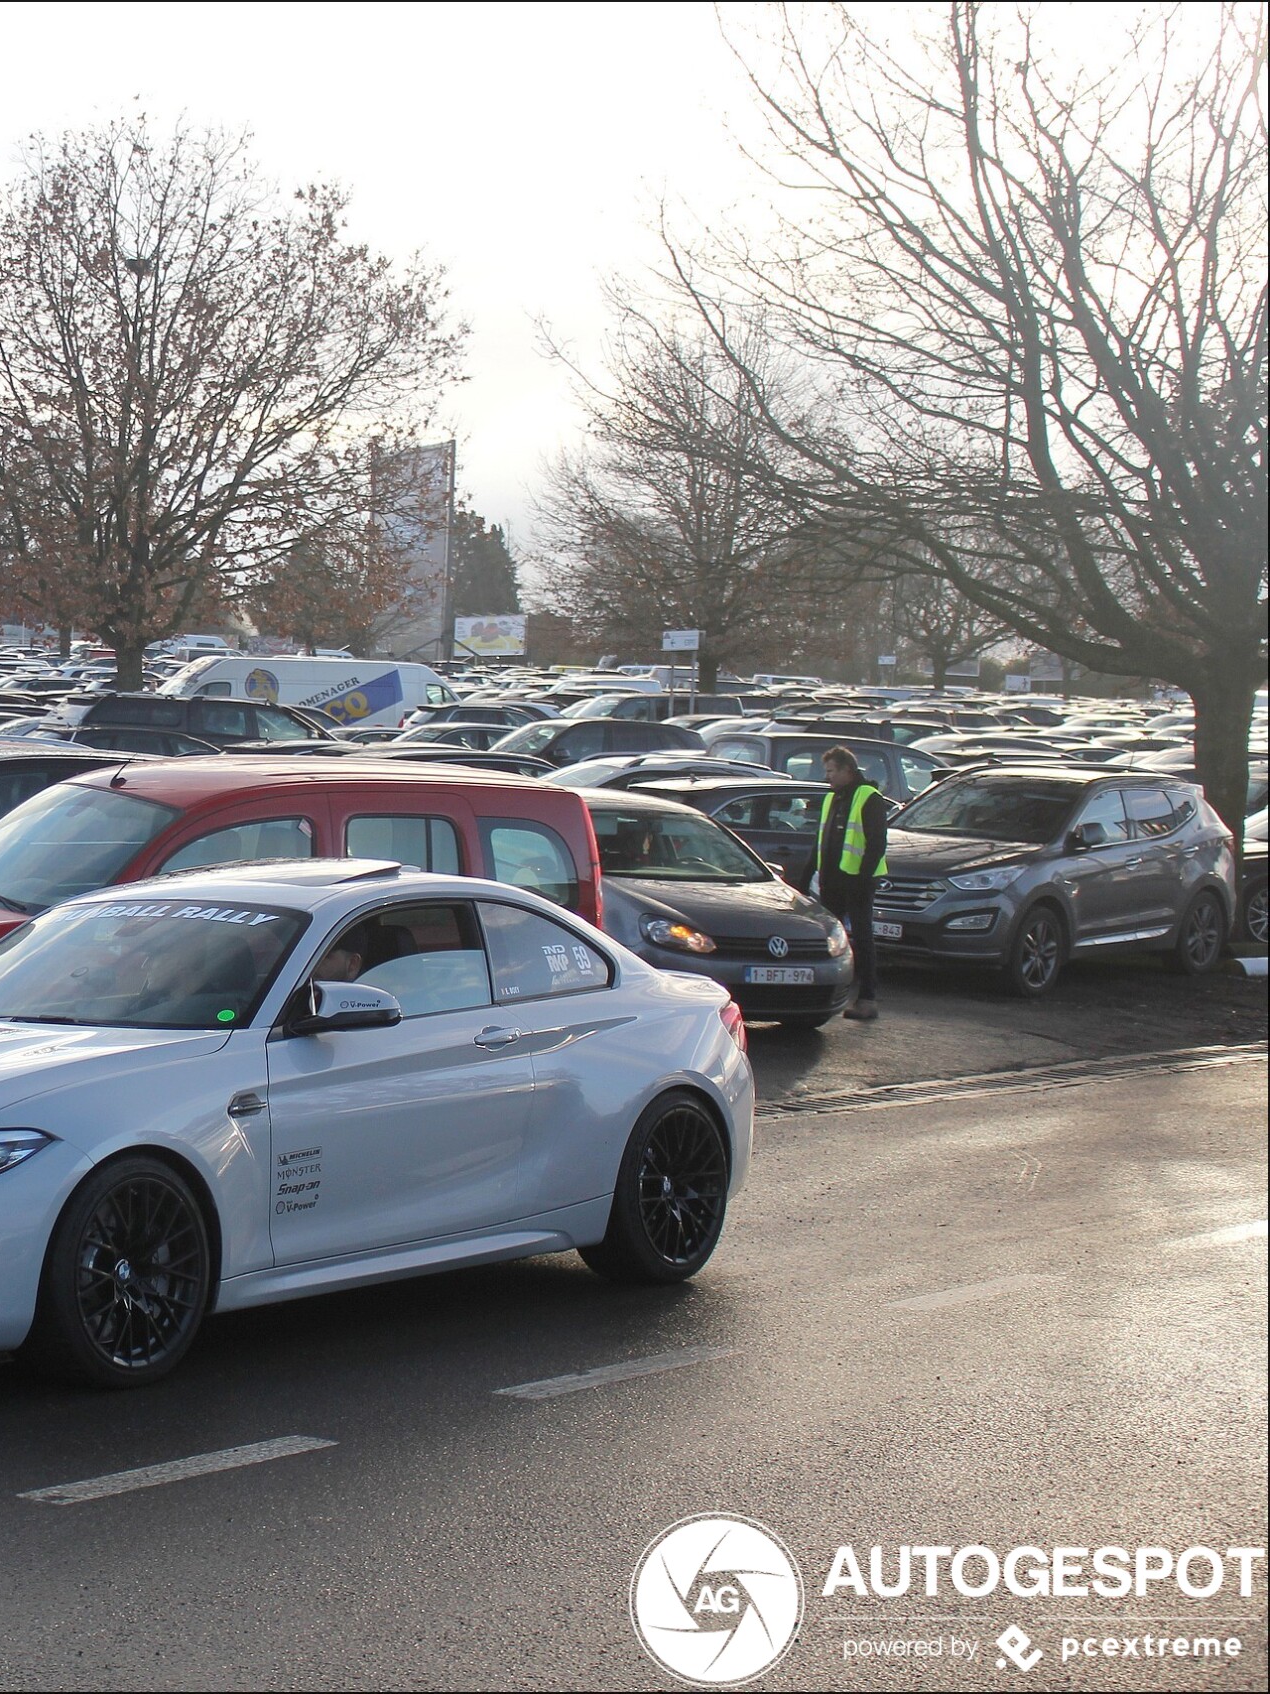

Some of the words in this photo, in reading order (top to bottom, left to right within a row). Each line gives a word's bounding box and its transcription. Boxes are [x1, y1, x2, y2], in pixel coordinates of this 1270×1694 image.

[171, 906, 279, 926] RALLY
[572, 945, 591, 971] 59
[289, 1149, 321, 1160] MICHELIN
[277, 1180, 321, 1195] Snap-on
[286, 1200, 317, 1213] V-Power
